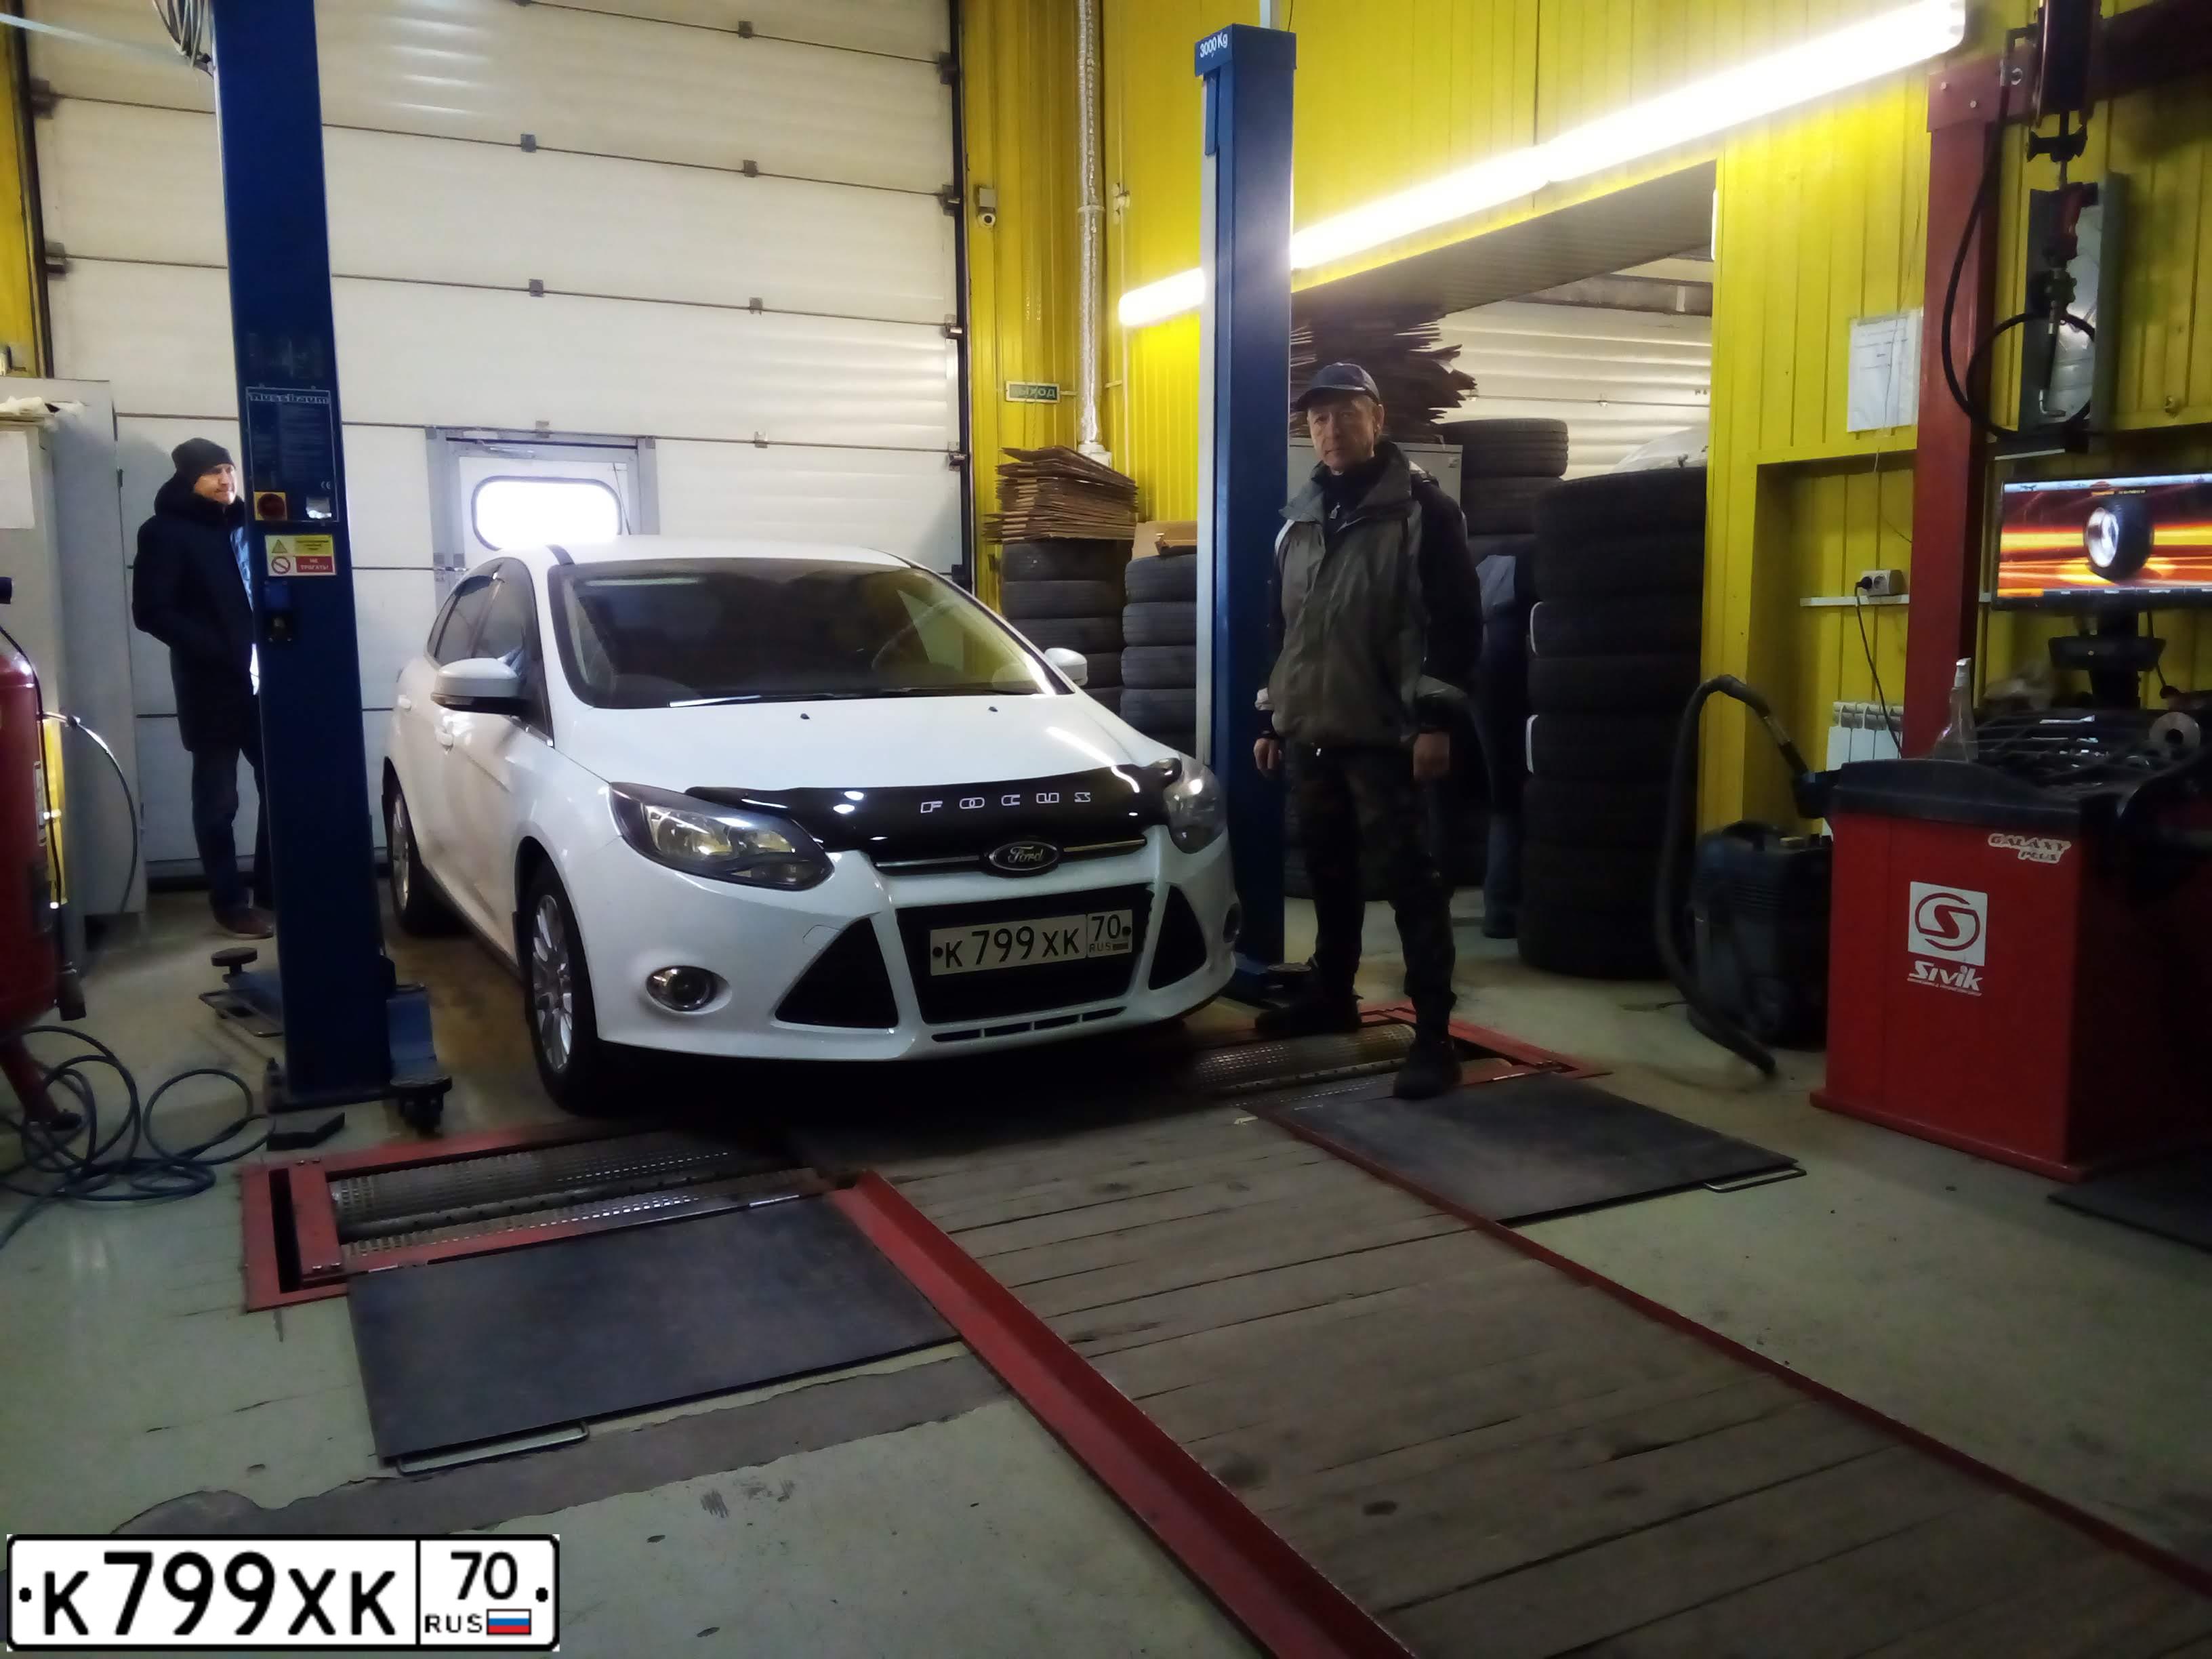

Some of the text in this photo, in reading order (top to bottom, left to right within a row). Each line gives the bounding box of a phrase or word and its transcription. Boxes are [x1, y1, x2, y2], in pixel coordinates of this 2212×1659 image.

[1200, 32, 1228, 58] 3000 Kg
[920, 792, 1090, 813] FOCUS
[1990, 836, 2068, 852] GALAXY
[1008, 845, 1044, 864] Ford
[1091, 914, 1122, 941] 70
[1088, 942, 1112, 953] RUS
